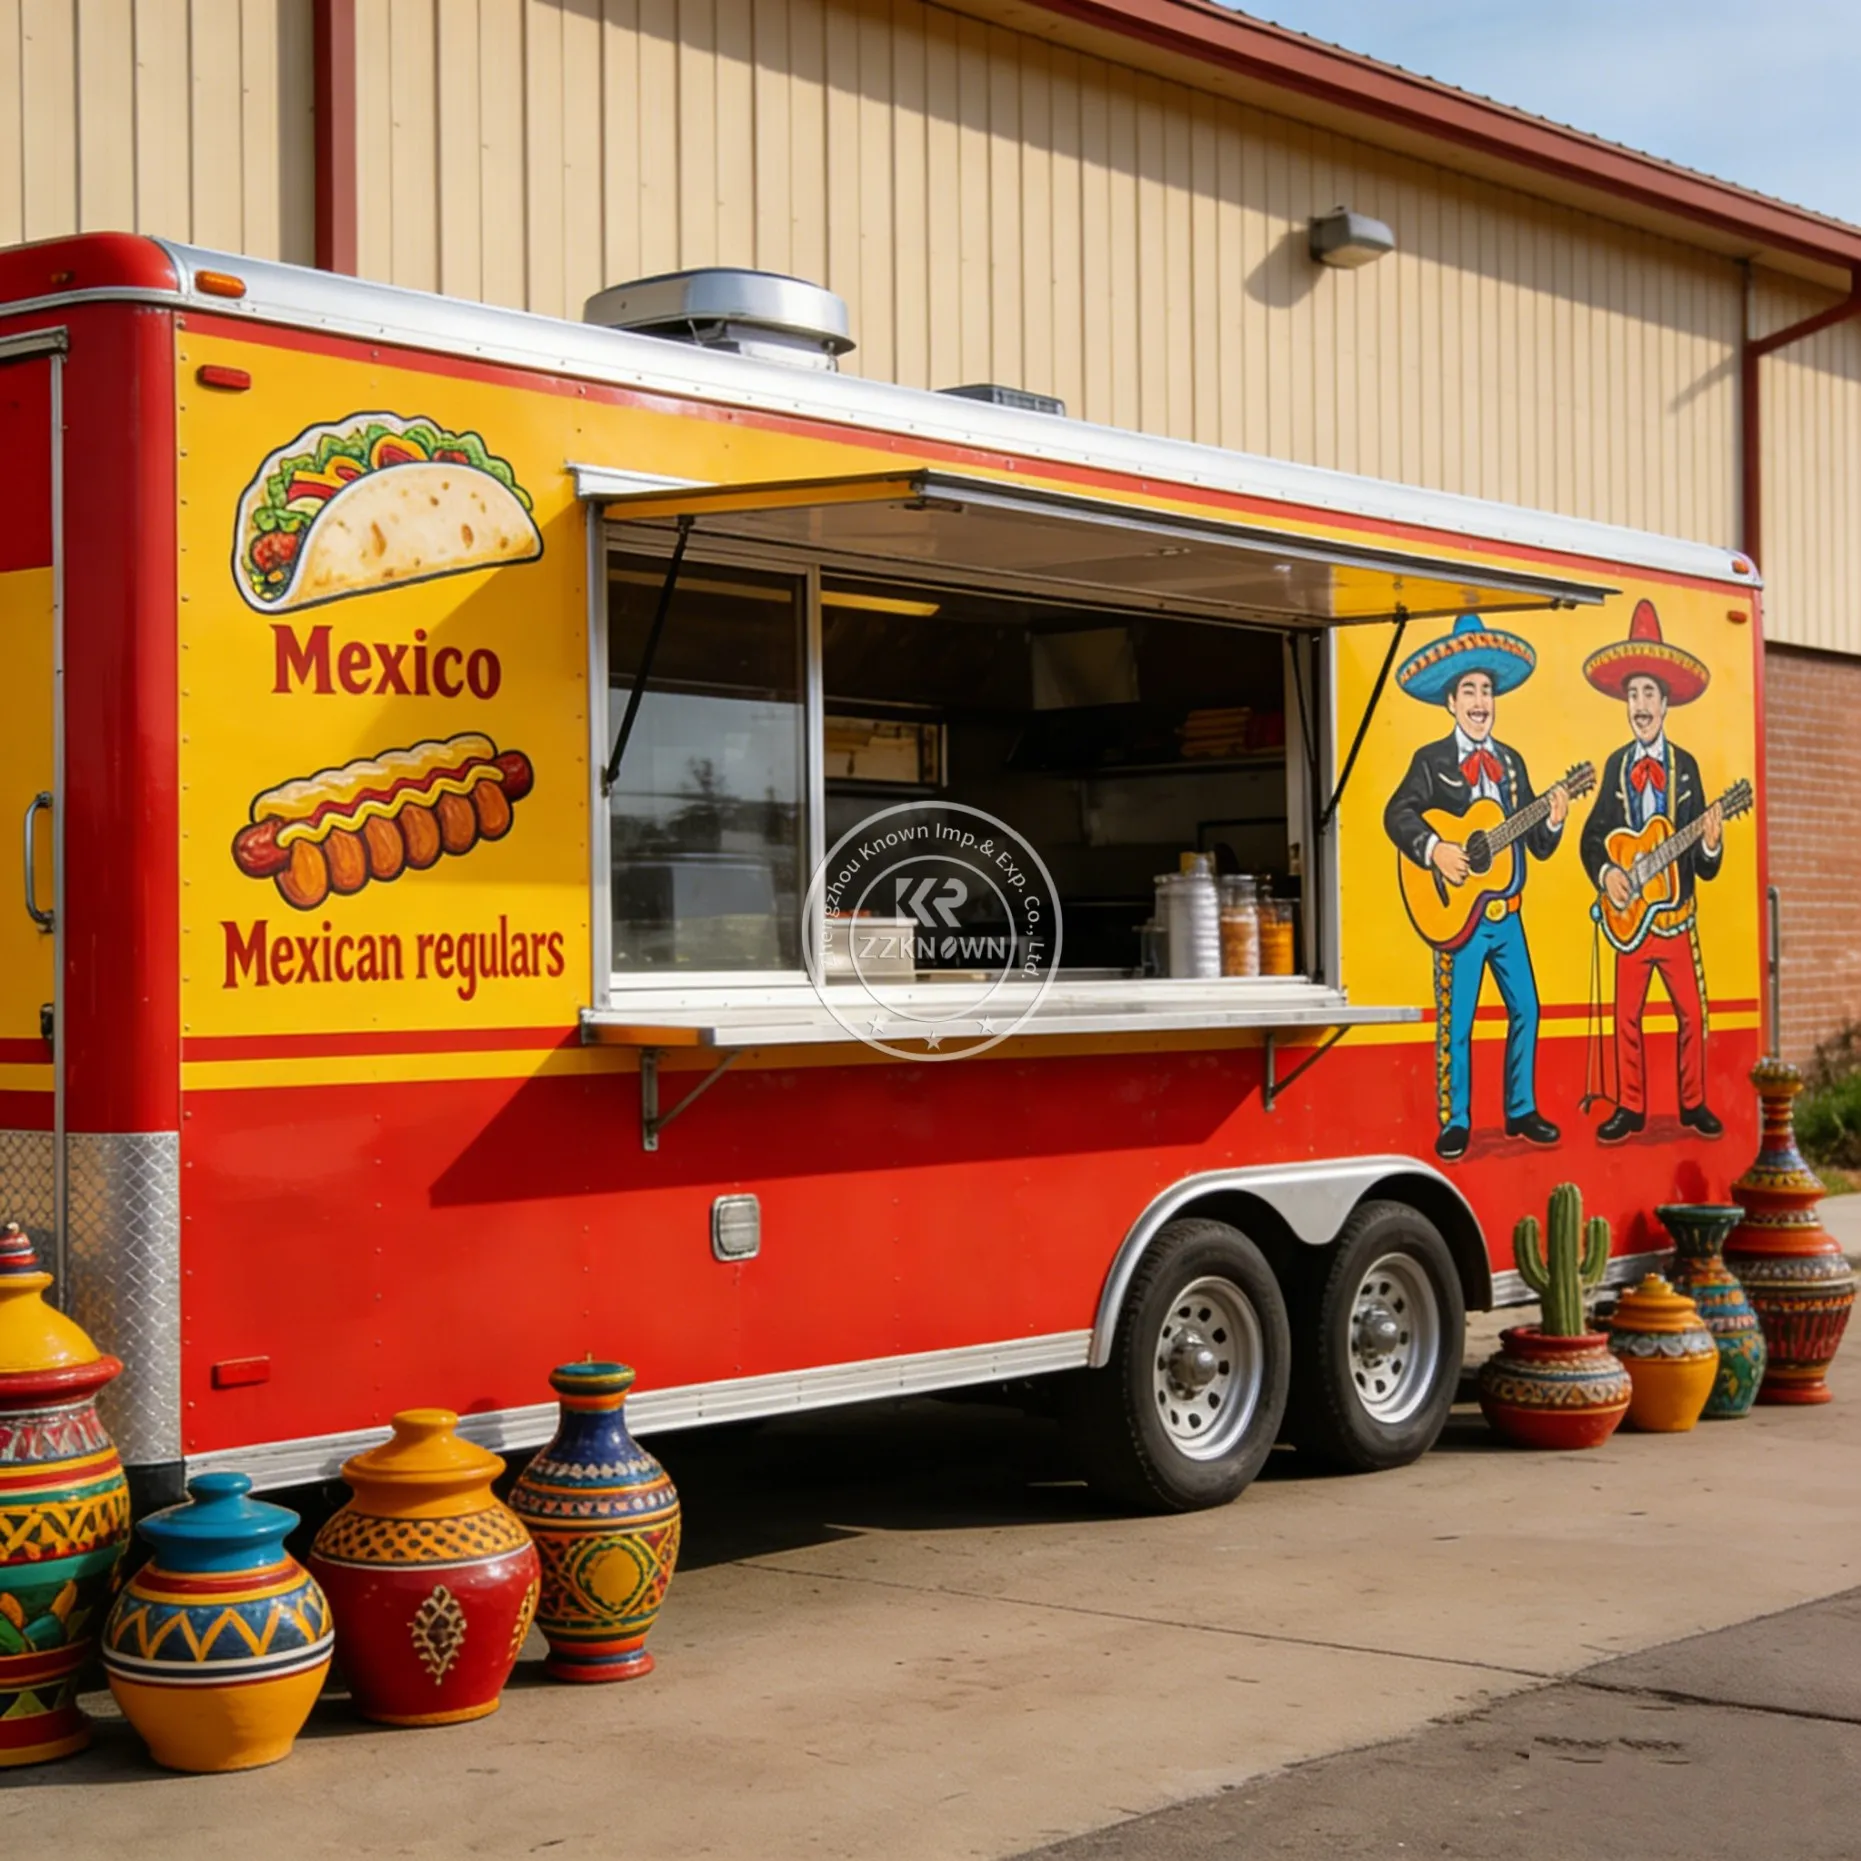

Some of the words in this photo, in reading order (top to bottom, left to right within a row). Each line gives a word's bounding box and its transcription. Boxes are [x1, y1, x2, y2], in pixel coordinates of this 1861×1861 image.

[270, 624, 501, 699] Mexico
[220, 920, 404, 989] Mexican
[416, 915, 564, 1001] regulars
